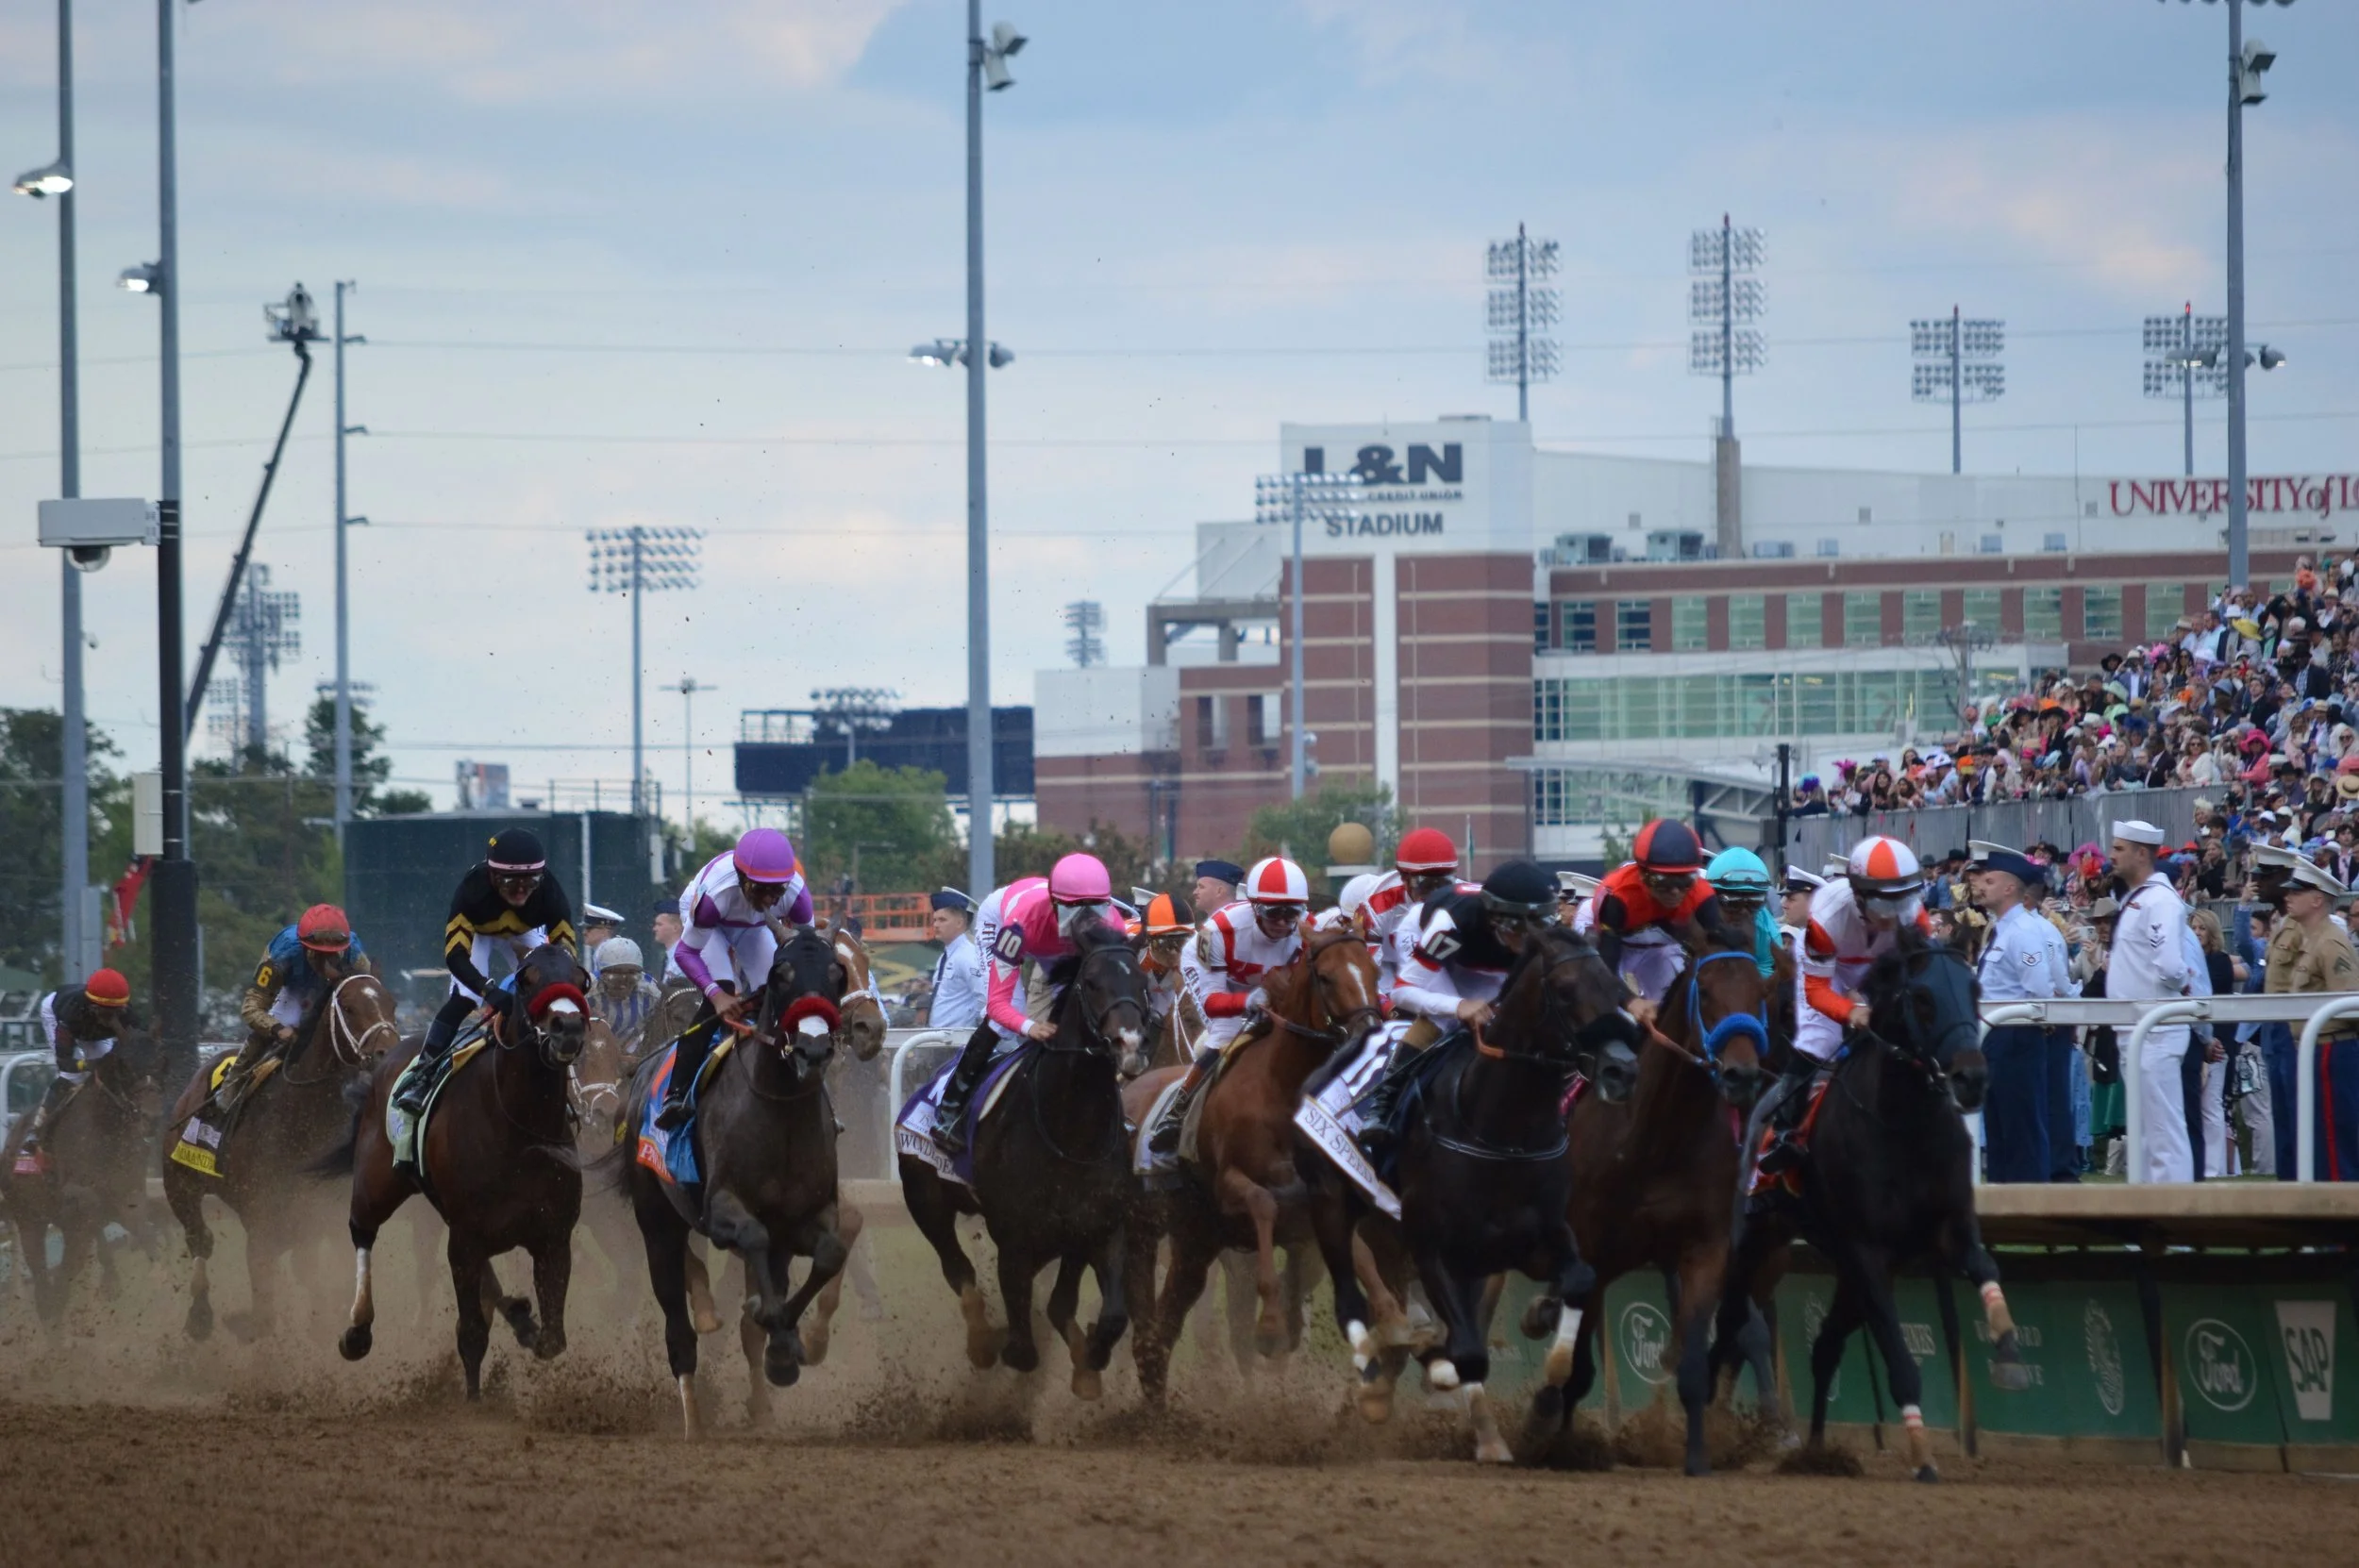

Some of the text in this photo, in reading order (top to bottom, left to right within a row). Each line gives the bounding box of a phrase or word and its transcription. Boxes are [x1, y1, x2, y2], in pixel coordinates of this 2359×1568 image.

[1420, 490, 1463, 501] UNION
[2109, 477, 2308, 516] UNIVERSITY
[2307, 475, 2334, 519] of
[1327, 513, 1444, 537] STADIUM
[997, 928, 1022, 959] 10
[1426, 932, 1462, 960] 17
[257, 965, 273, 988] 6
[1305, 1108, 1334, 1140] SIX
[1631, 1311, 1665, 1370] Ford
[2197, 1330, 2244, 1394] Ford
[2286, 1326, 2328, 1392] SAP
